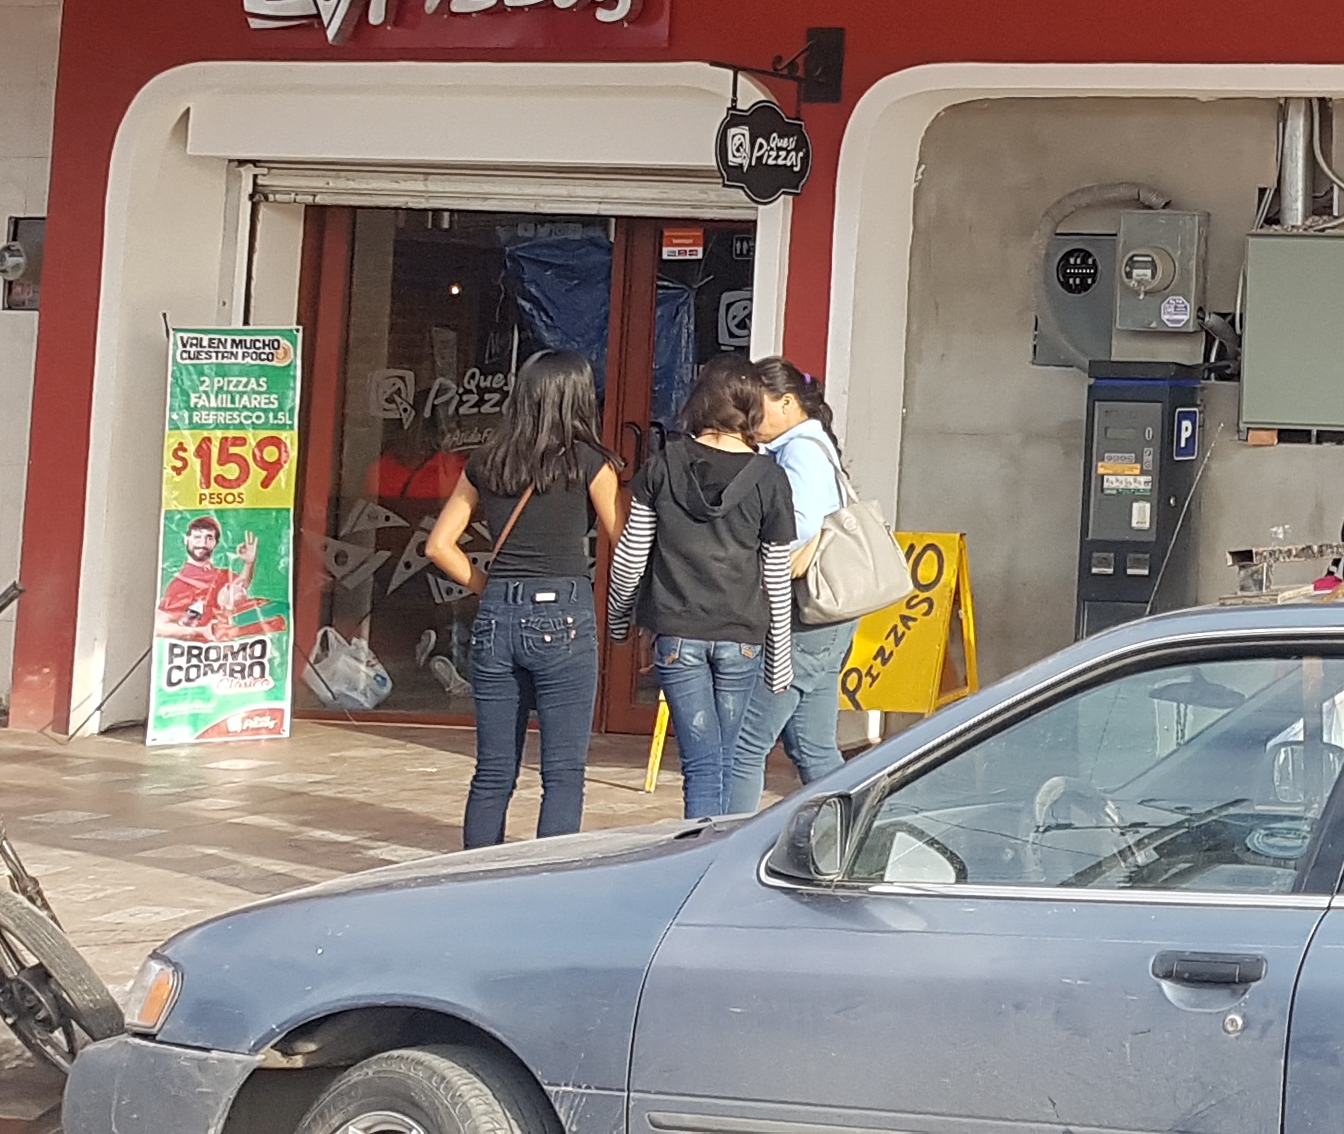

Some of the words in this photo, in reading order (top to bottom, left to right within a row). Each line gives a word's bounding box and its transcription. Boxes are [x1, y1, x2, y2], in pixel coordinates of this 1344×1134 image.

[770, 132, 797, 151] Quesi
[751, 137, 804, 172] Pizzas
[179, 336, 228, 349] VALEN
[230, 338, 280, 351] MUCHO
[180, 350, 238, 361] CUESTAN
[242, 351, 275, 362] POCO
[200, 377, 210, 391] 2
[213, 377, 268, 391] PIZZAS
[190, 394, 279, 408] FAMILIARES
[192, 411, 265, 425] REFRESCO
[269, 413, 293, 425] 1.5L
[1180, 419, 1193, 448] P
[171, 435, 290, 490] $159
[198, 492, 245, 505] PESOS
[168, 638, 268, 665] PROMO
[841, 594, 935, 712] PIZZAS
[166, 660, 267, 688] COMBO
